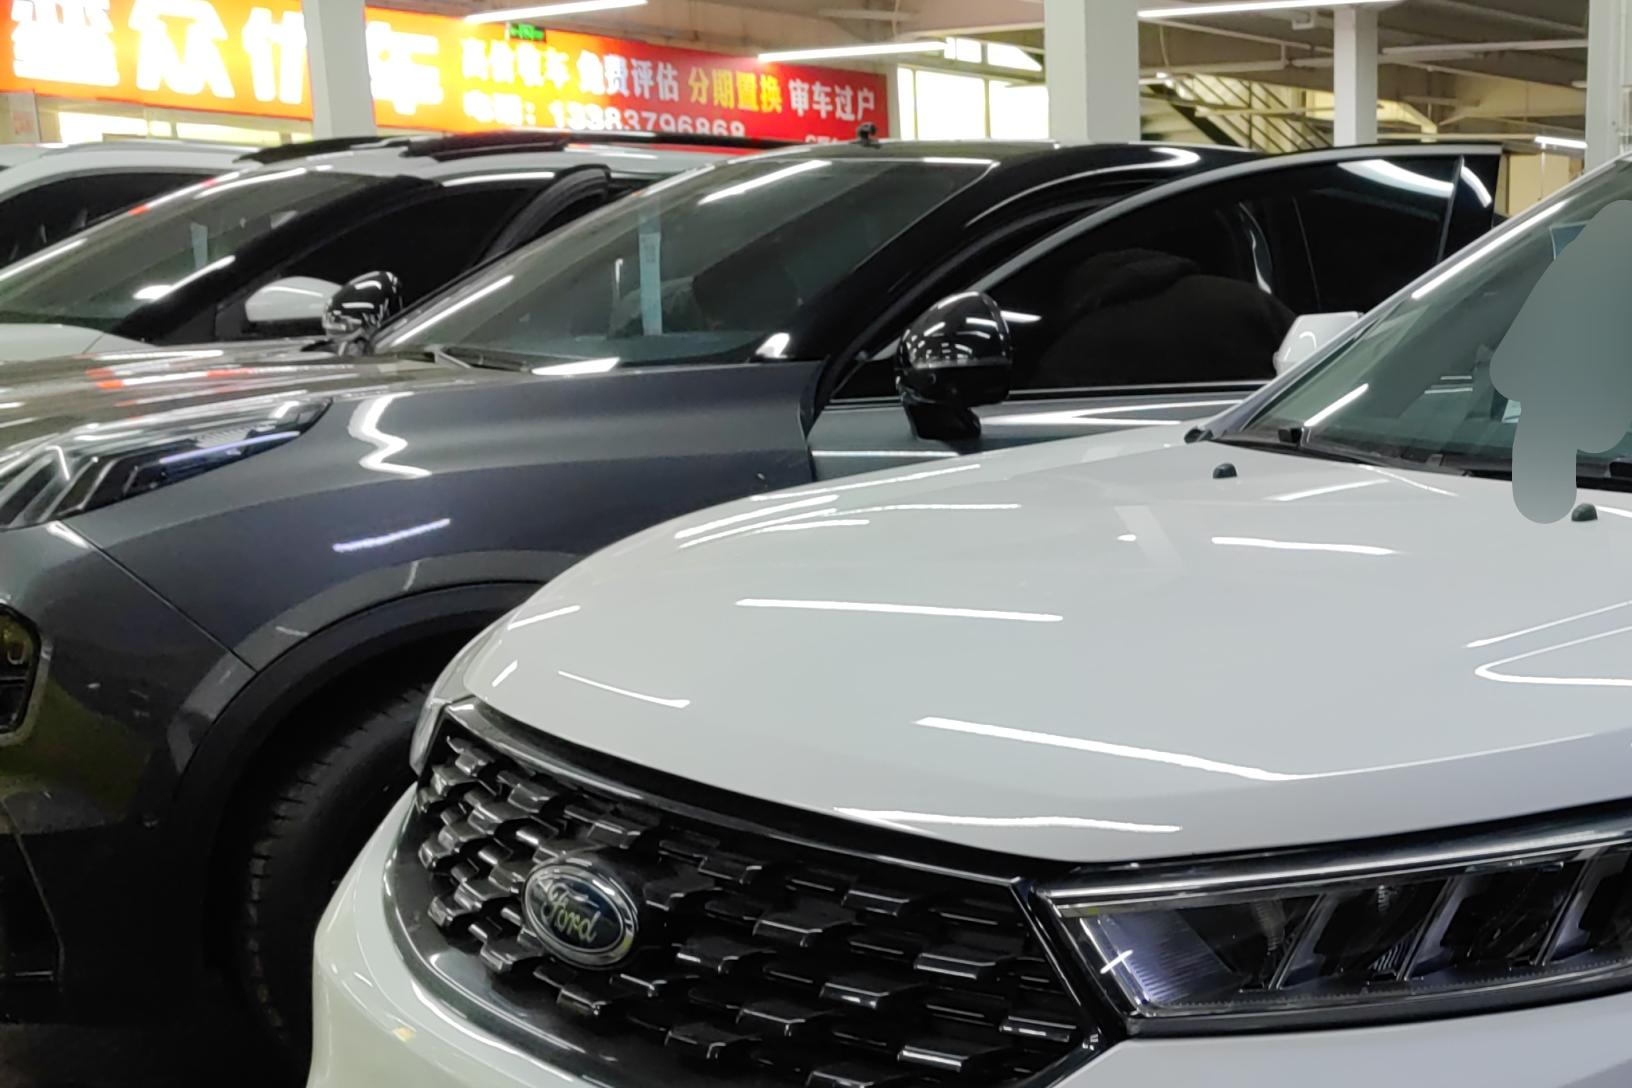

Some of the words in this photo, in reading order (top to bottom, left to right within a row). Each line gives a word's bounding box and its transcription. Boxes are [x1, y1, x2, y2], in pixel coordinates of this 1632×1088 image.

[576, 50, 680, 100] 免费评估
[687, 67, 782, 113] 分期置换
[787, 78, 875, 121] 审车过户
[541, 880, 601, 943] Ford
